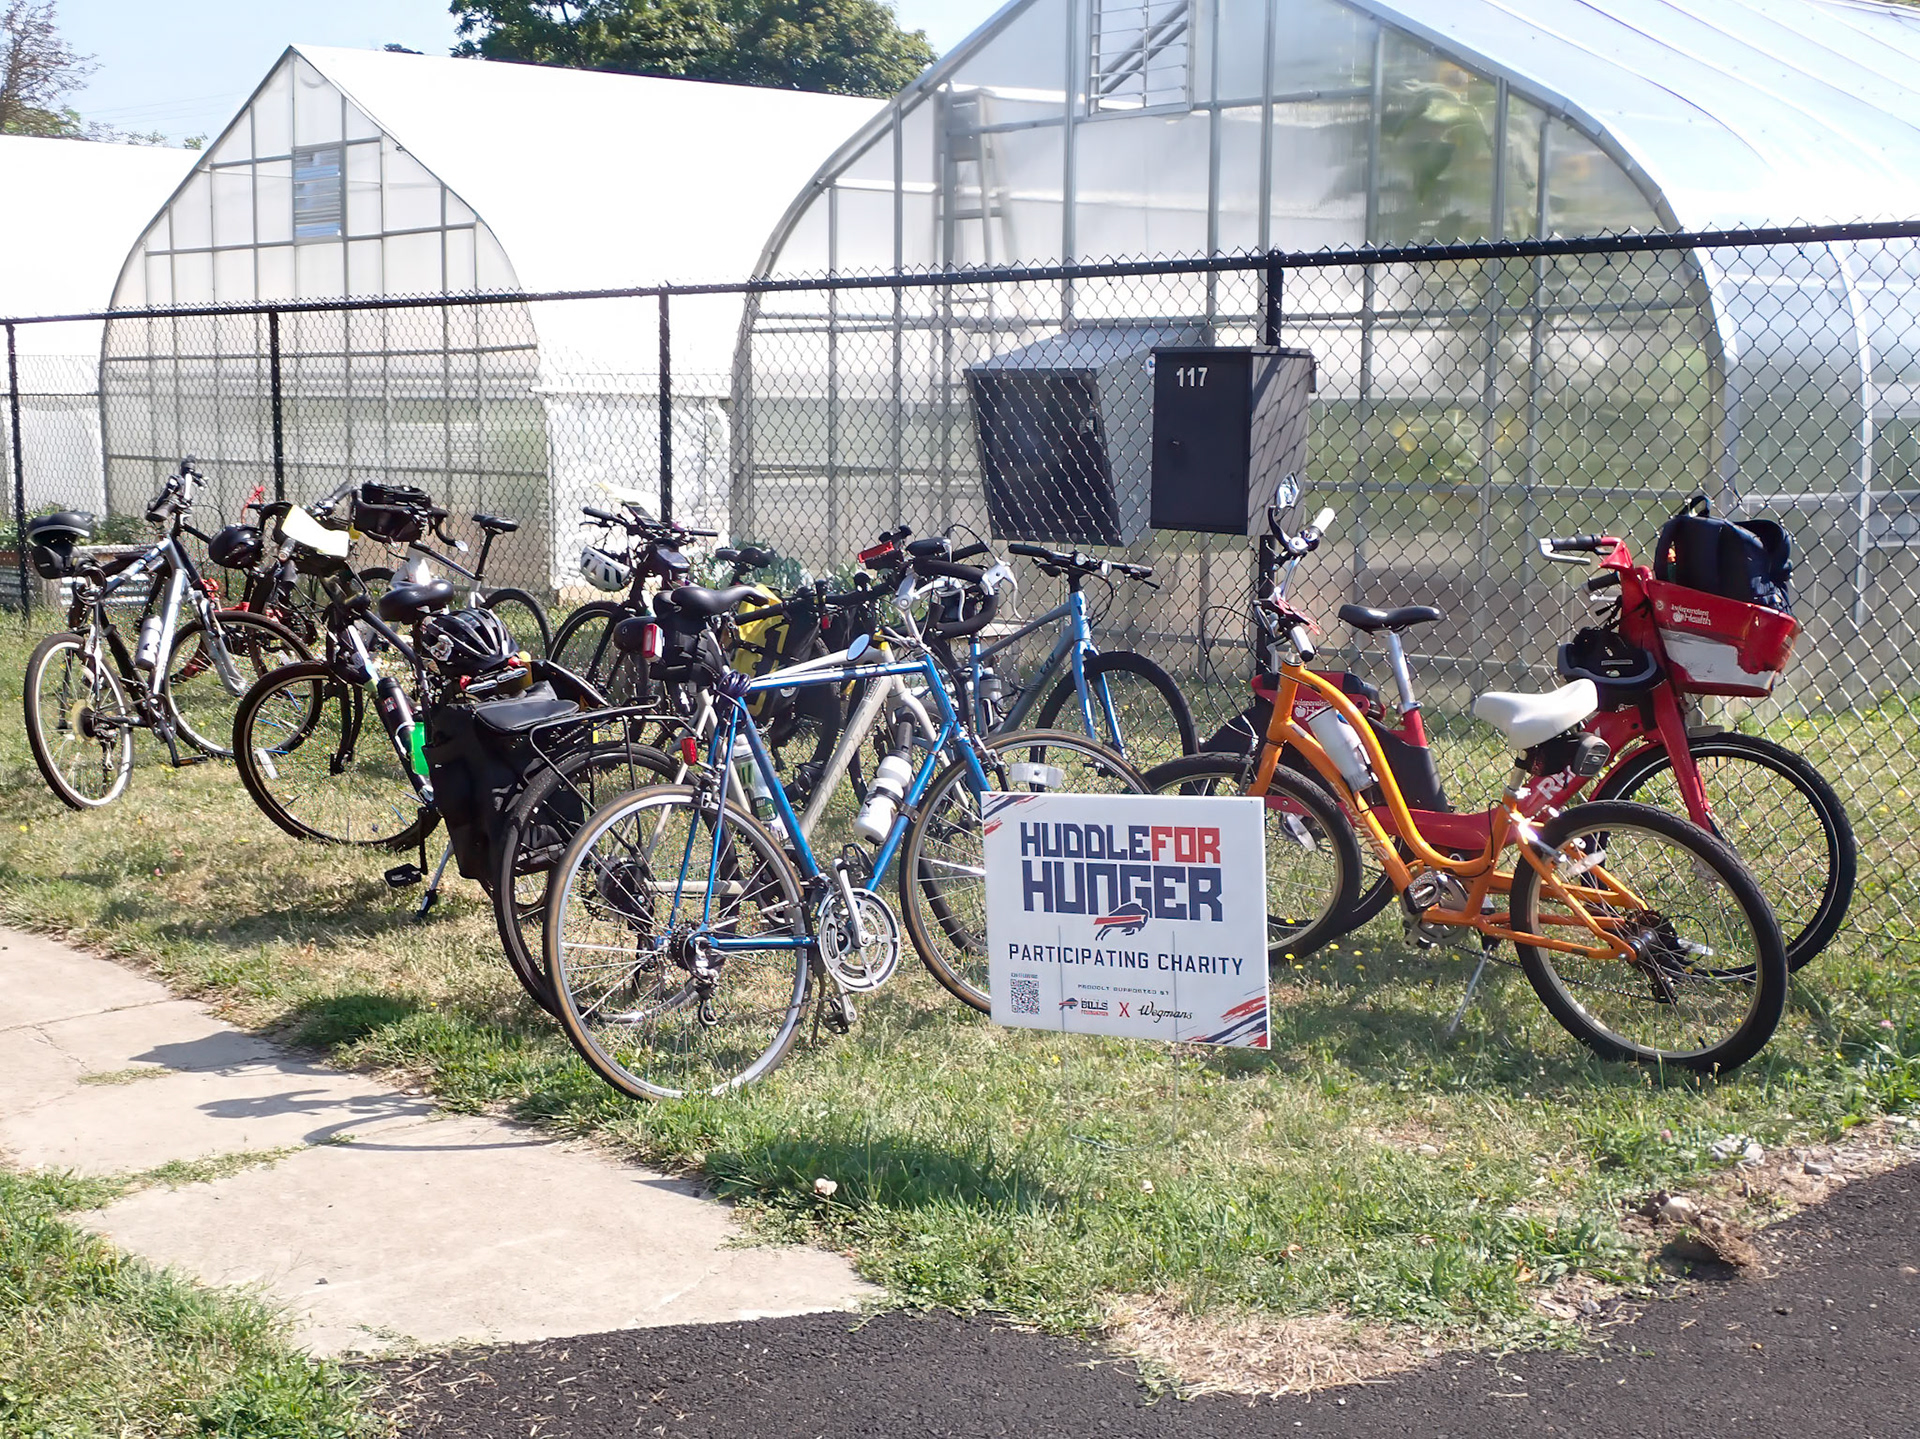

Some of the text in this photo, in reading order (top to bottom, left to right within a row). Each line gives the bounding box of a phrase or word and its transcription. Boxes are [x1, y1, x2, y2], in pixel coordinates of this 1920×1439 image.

[1176, 367, 1208, 387] 117
[1684, 612, 1711, 626] Health
[1022, 859, 1223, 922] HUNGER
[1009, 944, 1243, 976] PARTICIPATING CHARITY
[1081, 1000, 1109, 1011] BILLS
[1137, 1001, 1193, 1023] Wegmans
